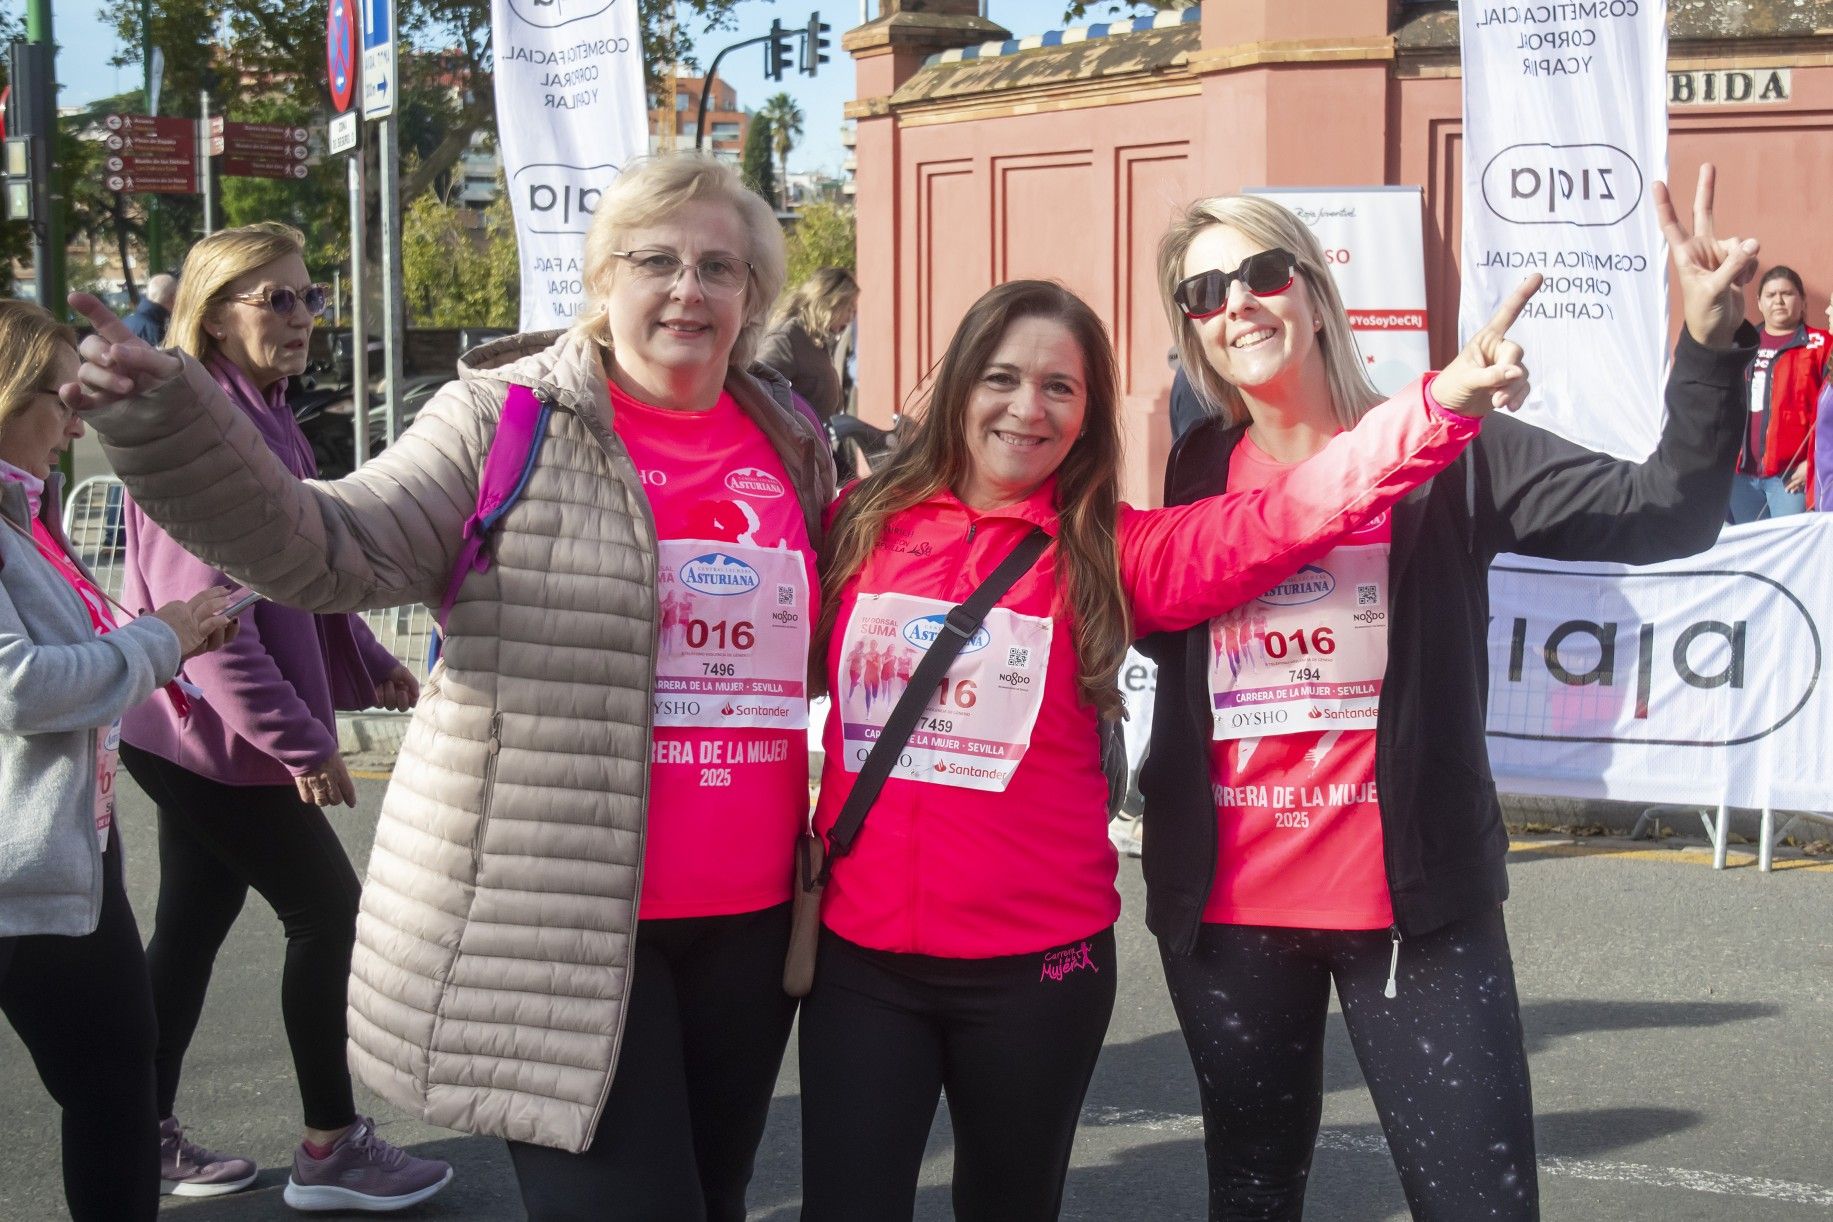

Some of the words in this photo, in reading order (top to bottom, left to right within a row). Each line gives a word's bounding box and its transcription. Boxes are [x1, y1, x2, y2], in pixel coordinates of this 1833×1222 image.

[1670, 70, 1788, 102] BIDA
[731, 476, 782, 494] ASTURIANA
[686, 566, 754, 587] ASTURIANA
[686, 619, 755, 650] 016
[860, 624, 897, 638] SUMA
[909, 624, 983, 647] ASTNA
[1264, 627, 1336, 659] 016
[702, 663, 735, 676] 7496
[1288, 668, 1321, 683] 7494
[1490, 616, 1747, 720] iaja
[690, 682, 701, 690] DE
[702, 682, 713, 691] LA
[715, 682, 744, 692] MUJER
[752, 683, 784, 693] SEVILLA
[936, 677, 978, 709] 16
[1236, 692, 1274, 703] CARRERA
[1276, 690, 1288, 699] DE
[1290, 688, 1300, 698] LA
[1300, 686, 1330, 696] MUJER
[1338, 684, 1376, 696] SEVILLA
[654, 700, 701, 716] YSHO
[736, 704, 790, 718] Santander
[1324, 706, 1379, 720] Santande
[920, 716, 953, 733] 7459
[1232, 709, 1288, 728] OYSHO
[700, 741, 724, 764] DE
[726, 742, 744, 764] LA
[747, 740, 788, 764] MUJER
[917, 736, 928, 744] LA
[930, 737, 960, 750] MUJER
[968, 742, 1004, 756] SEVILLA
[700, 769, 732, 786] 2025
[949, 763, 1007, 780] Santander
[1213, 784, 1268, 808] RRERA
[1272, 786, 1296, 808] DE
[1300, 784, 1324, 808] LA
[1328, 782, 1377, 807] MUJE
[1275, 812, 1310, 828] 2025
